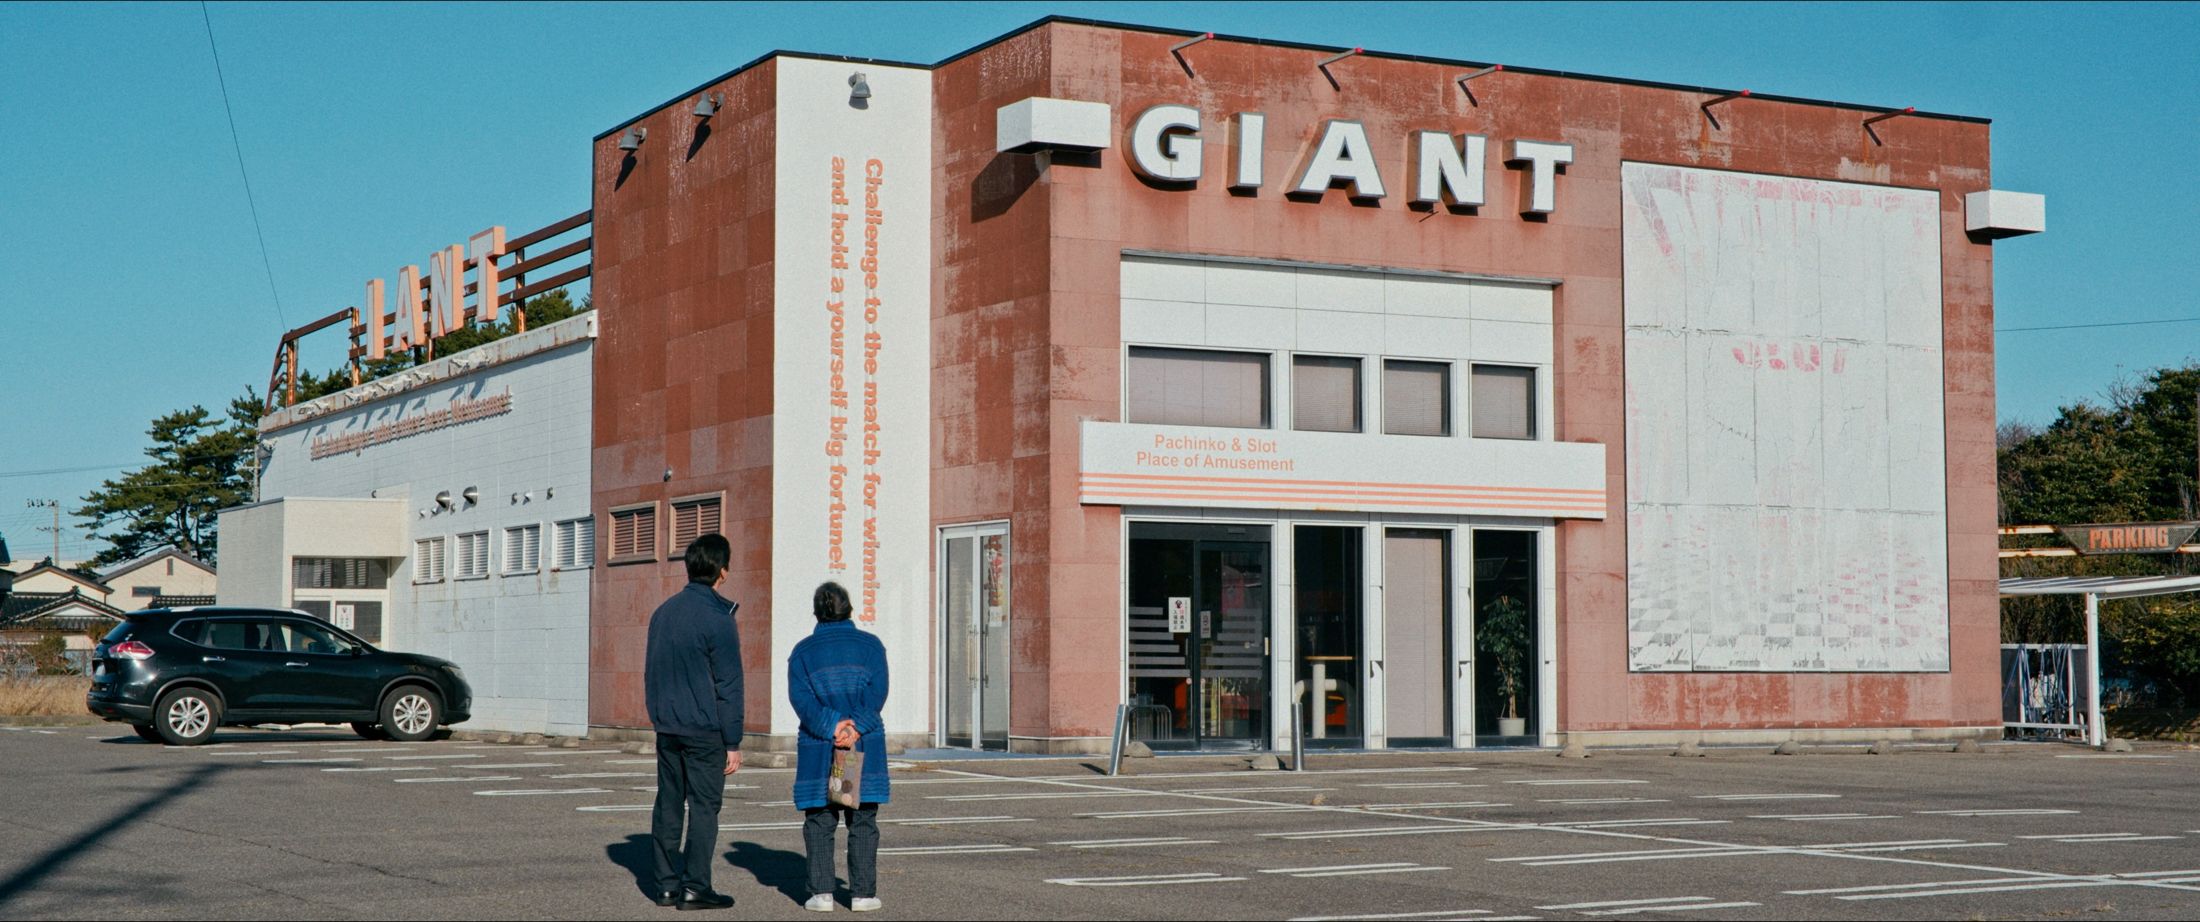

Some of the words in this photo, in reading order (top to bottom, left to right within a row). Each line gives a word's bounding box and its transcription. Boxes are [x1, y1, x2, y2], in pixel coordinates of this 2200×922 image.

[831, 156, 849, 205] and
[1124, 103, 1575, 219] GIANT
[831, 212, 849, 270] hold
[860, 158, 883, 289] Challenge
[366, 226, 506, 360] IANT
[831, 276, 845, 293] a
[864, 297, 882, 324] to
[826, 300, 848, 410] yourself
[864, 331, 882, 375] the
[825, 416, 848, 457] big
[863, 382, 882, 465] match
[1155, 434, 1226, 451] Pachinko
[1231, 438, 1242, 452] &
[1247, 438, 1278, 453] Slot
[1136, 451, 1180, 467] Place
[1184, 454, 1200, 468] of
[1204, 455, 1295, 471] Amusement
[829, 461, 848, 570] fortune!
[863, 472, 882, 510] for
[2089, 527, 2169, 549] PARKING
[859, 517, 881, 622] winning
